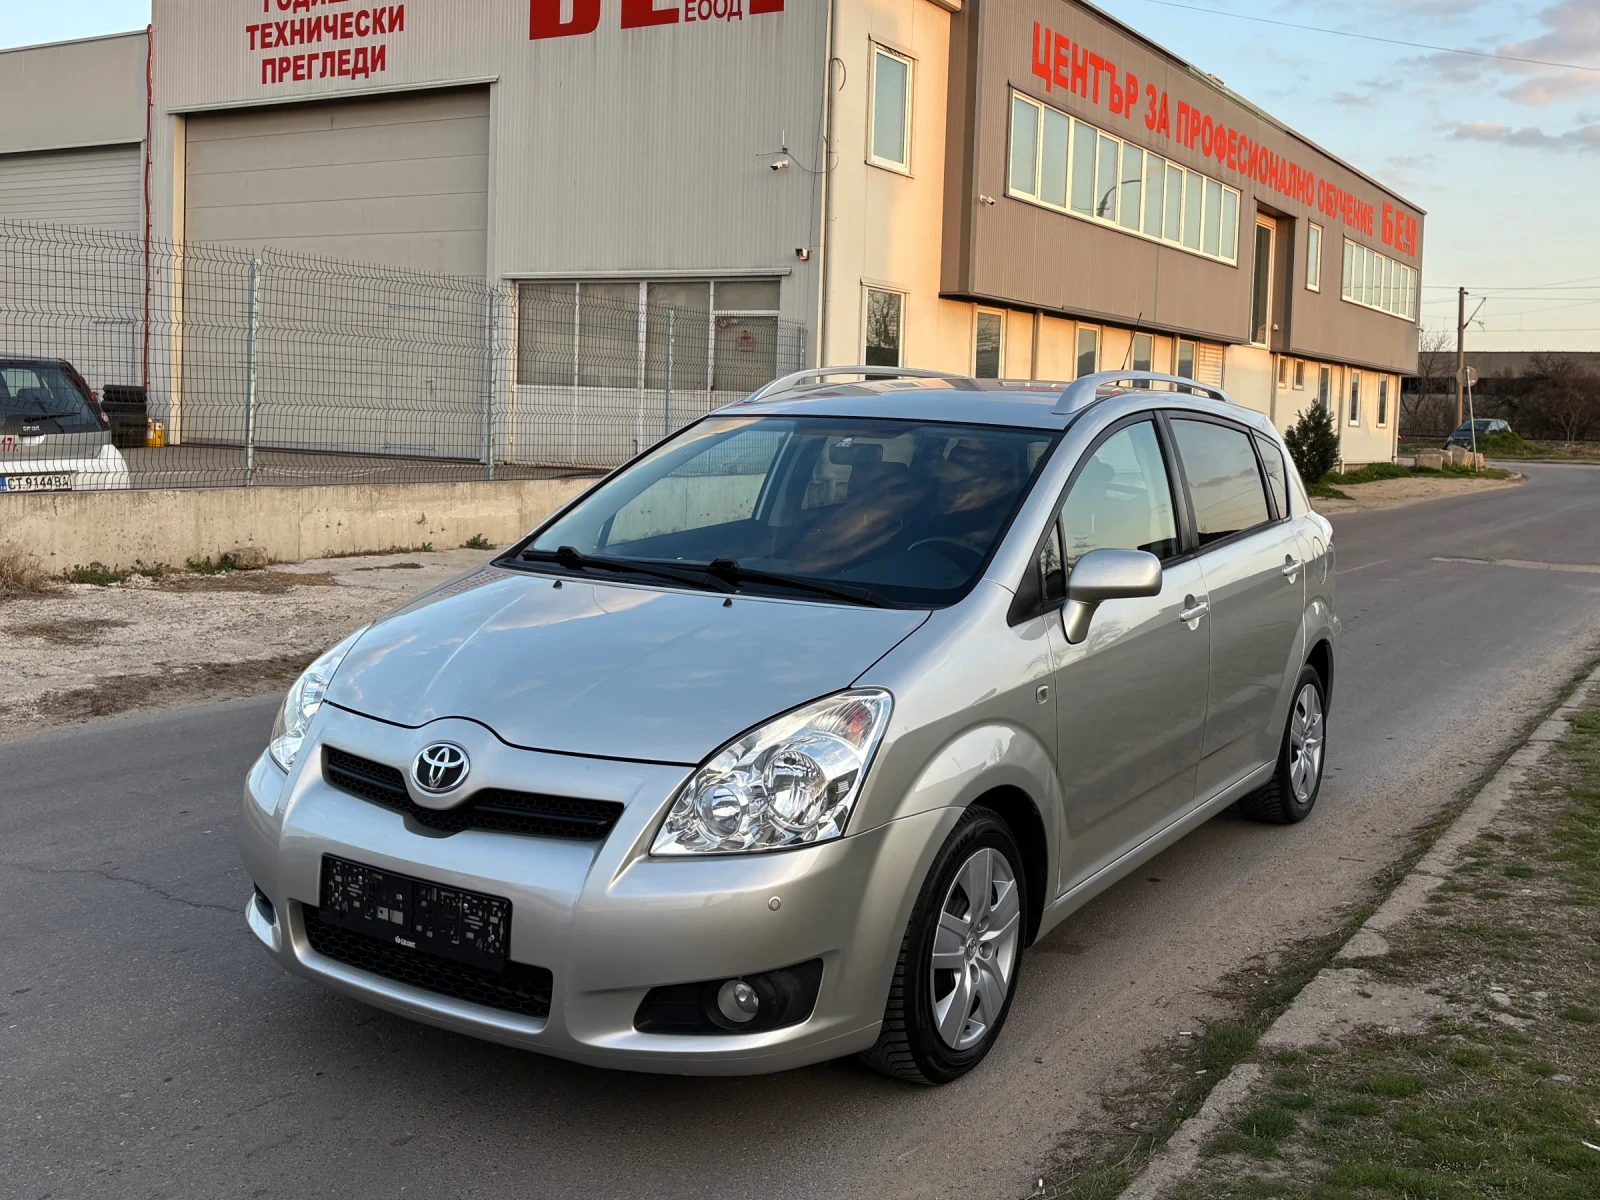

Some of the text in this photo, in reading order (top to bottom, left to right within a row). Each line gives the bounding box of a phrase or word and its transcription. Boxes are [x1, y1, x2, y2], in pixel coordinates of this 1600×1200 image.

[246, 4, 405, 50] ТЕХНИЧЕСКИ
[684, 0, 743, 22] ЕООД
[261, 44, 387, 84] ПРЕГЛЕДИ
[1032, 21, 1139, 120] ЦЕНТЪР
[1145, 83, 1171, 139] ЗА
[1176, 100, 1315, 207] ПРОФЕСИОНАЛНО
[1318, 178, 1375, 237] ОБУЧЕНИЕ
